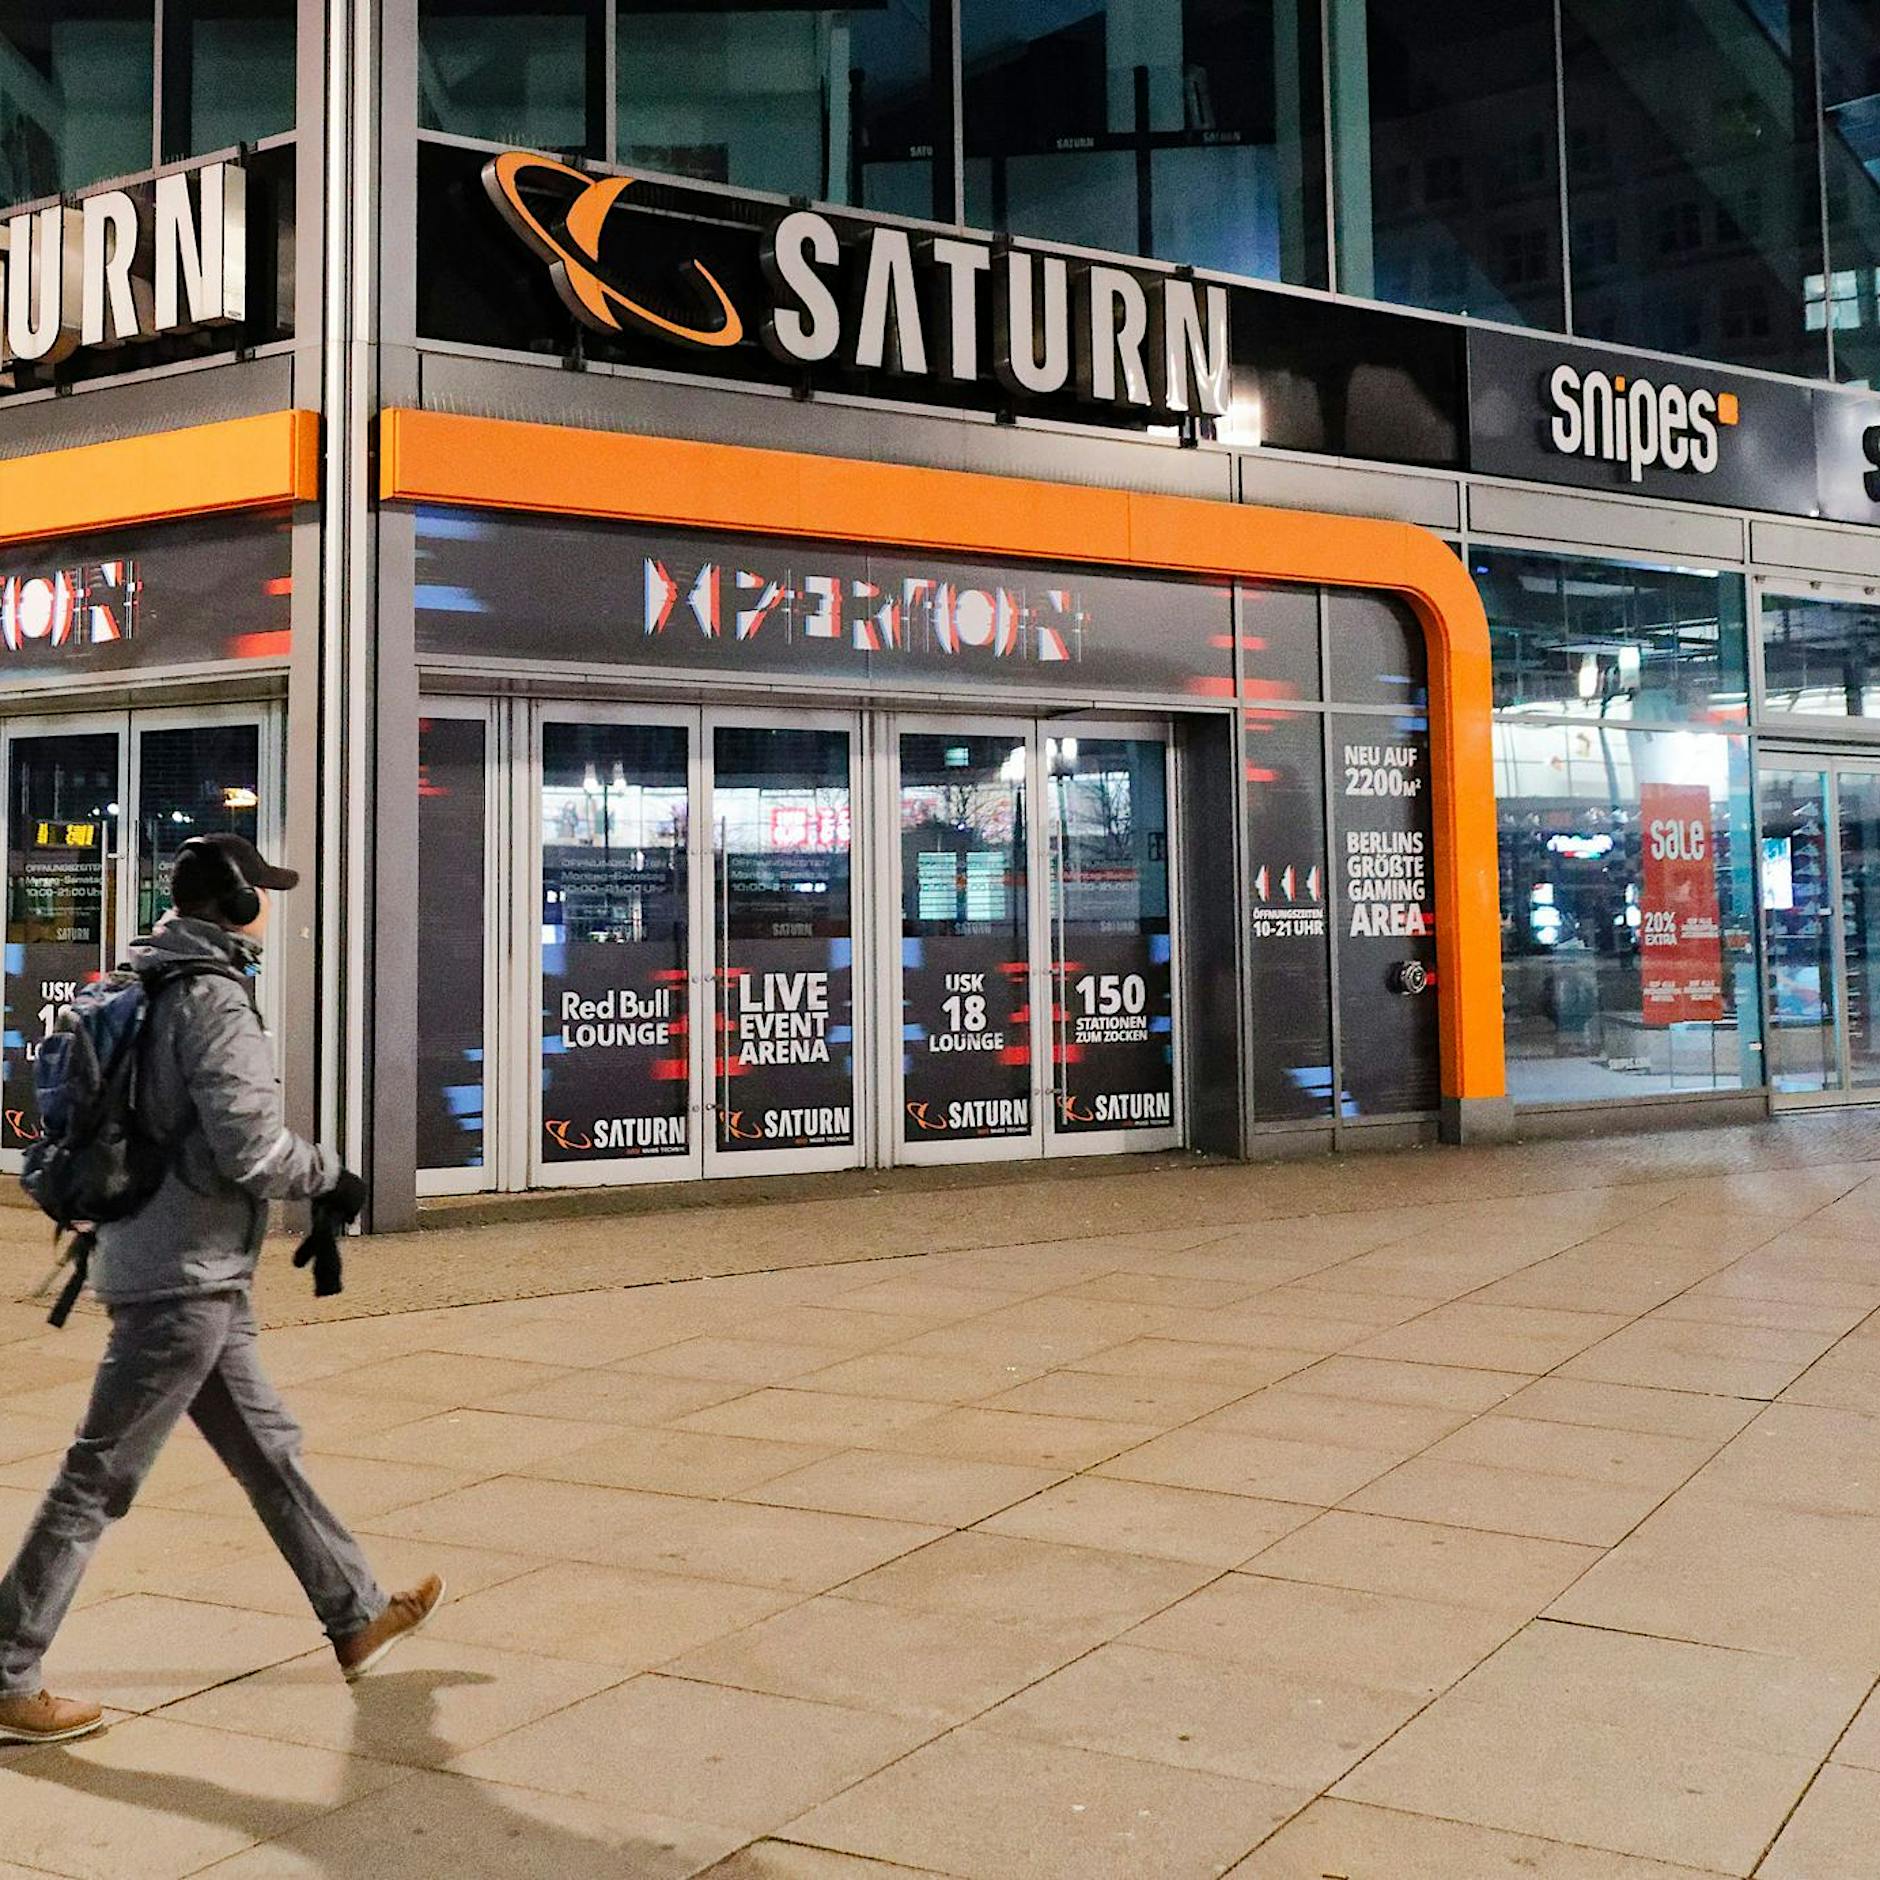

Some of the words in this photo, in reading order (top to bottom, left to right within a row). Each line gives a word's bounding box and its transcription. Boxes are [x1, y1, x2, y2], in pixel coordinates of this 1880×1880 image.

[1057, 137, 1094, 150] SATURN
[0, 162, 226, 361] URN
[774, 210, 1229, 417] SATURN
[1344, 746, 1380, 766] NEU
[1384, 748, 1418, 767] AUF
[1347, 832, 1424, 854] BERLINS
[1348, 878, 1426, 901] GAMING
[772, 922, 813, 937] SATURN
[1253, 920, 1293, 937] 10-21
[1294, 920, 1325, 936] UHR
[1350, 903, 1427, 937] AREA
[1644, 911, 1677, 933] 20%
[56, 926, 90, 942] SATURN
[1644, 934, 1678, 946] EXTRA
[41, 982, 76, 1002] USK
[739, 972, 828, 1012] LIVE
[945, 974, 985, 993] USK
[1075, 975, 1146, 1015] 150
[561, 990, 614, 1020] Red
[620, 988, 669, 1019] Bull
[942, 995, 987, 1032] 18
[561, 1022, 670, 1048] LOUNGE
[739, 1011, 830, 1040] EVENT
[1075, 1016, 1148, 1032] STATIONEN
[1075, 1030, 1102, 1043] ZUM
[1103, 1029, 1148, 1043] ZOCKEN
[738, 1039, 830, 1065] ARENA
[929, 1032, 1005, 1052] LOUNGE
[948, 1099, 1028, 1130] SATURN
[1095, 1092, 1171, 1122] SATURN
[593, 1116, 686, 1148] SATURN
[764, 1106, 850, 1138] SATURN
